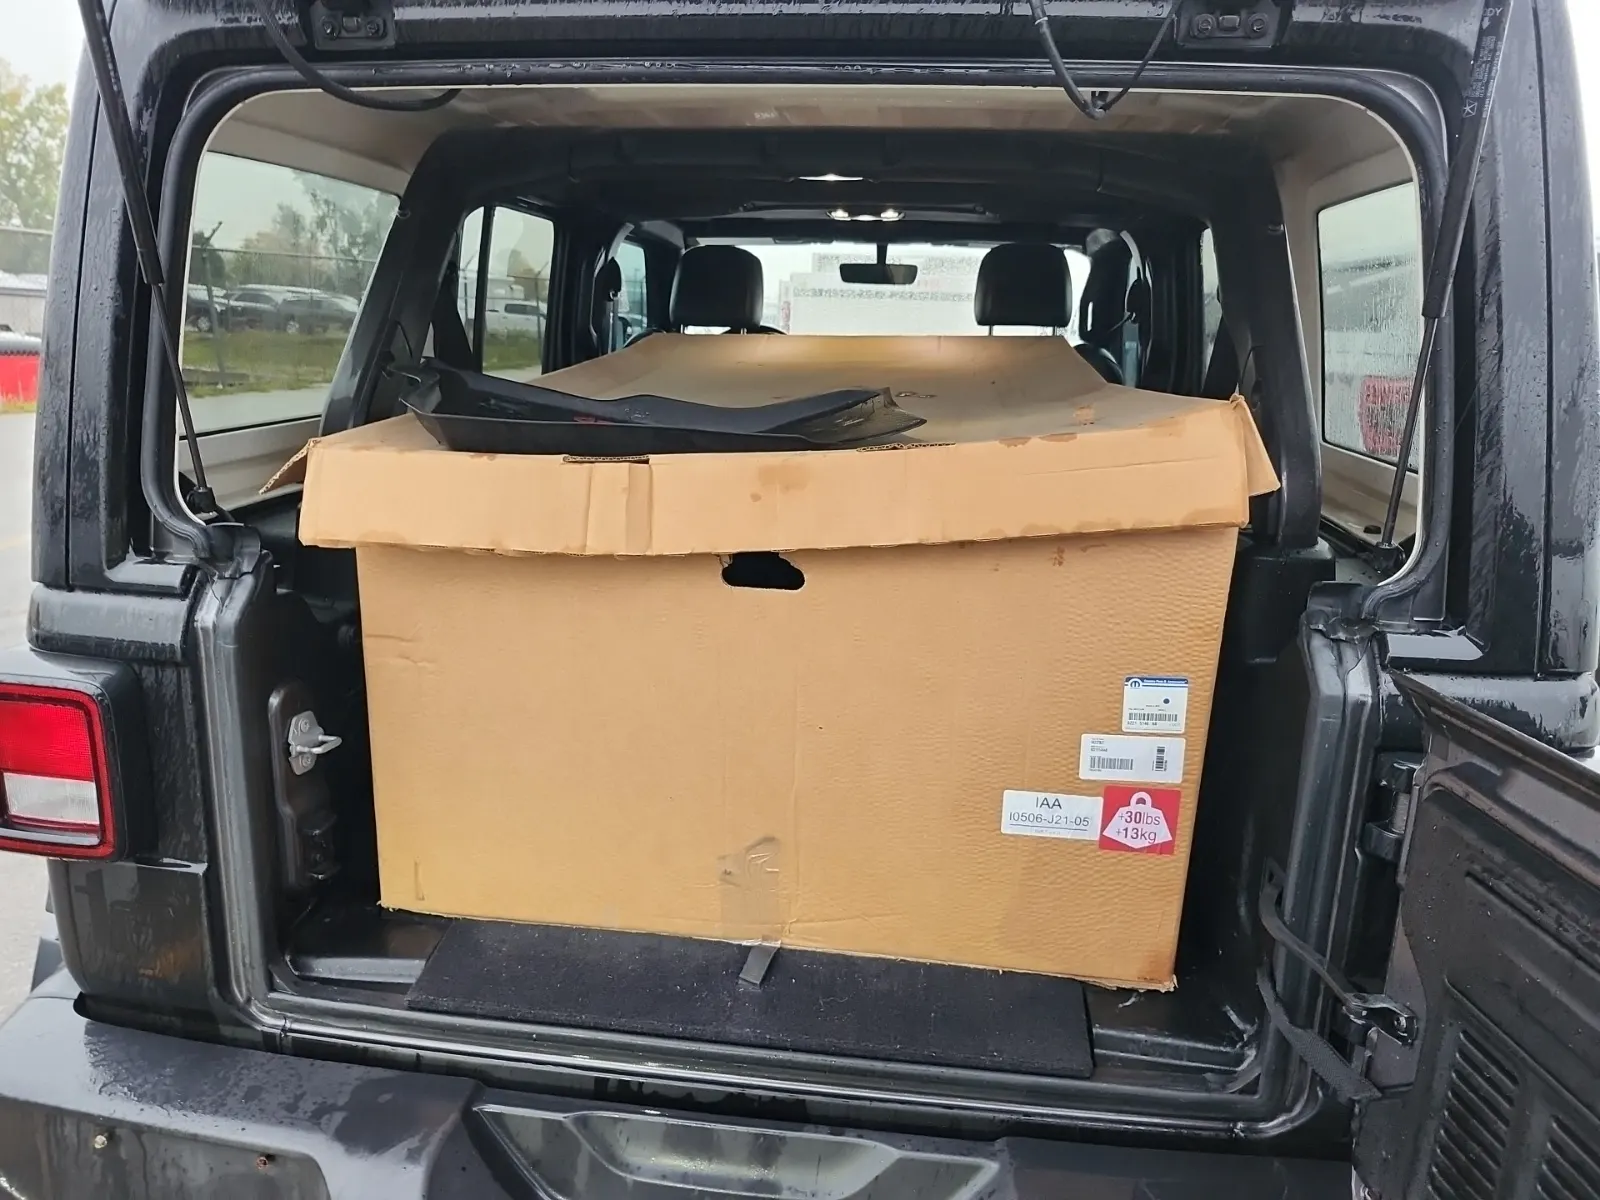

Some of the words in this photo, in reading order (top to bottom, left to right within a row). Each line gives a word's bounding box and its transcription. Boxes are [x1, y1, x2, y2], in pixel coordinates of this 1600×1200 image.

[1035, 796, 1063, 810] IAA
[1009, 811, 1090, 827] I0506-J21-05
[1118, 810, 1161, 826] +30lbs
[1115, 827, 1157, 844] +13kg
